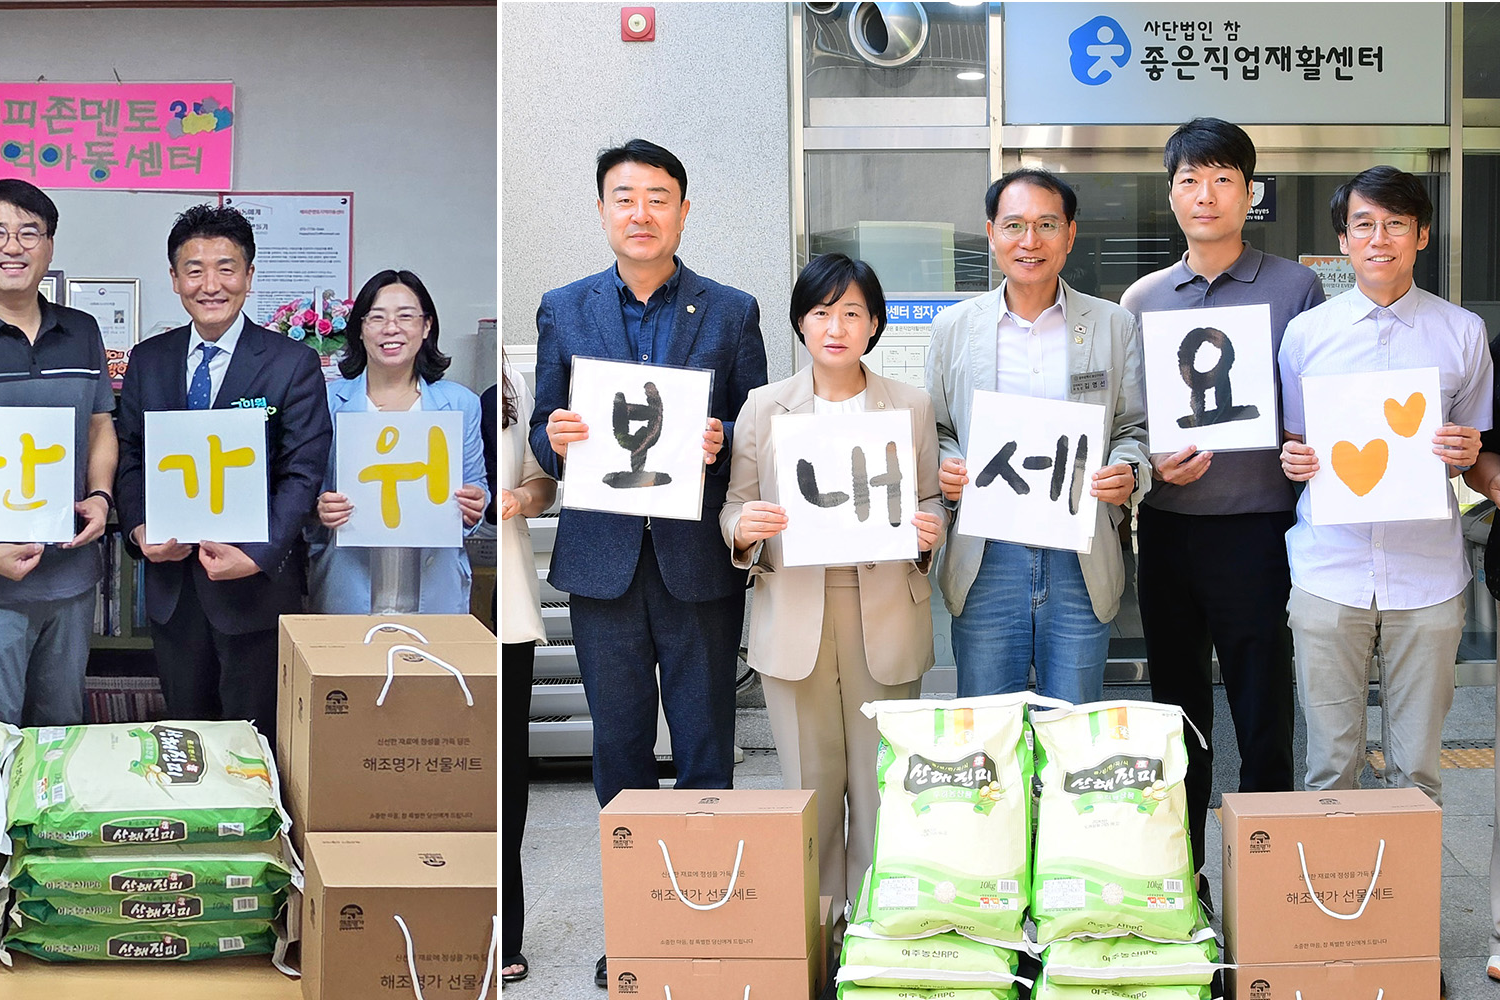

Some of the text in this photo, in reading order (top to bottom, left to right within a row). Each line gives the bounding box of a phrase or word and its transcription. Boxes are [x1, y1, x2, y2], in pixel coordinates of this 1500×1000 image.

[1143, 20, 1241, 41] 사단법인 참
[1140, 45, 1383, 81] 좋은직업재활센터
[913, 304, 934, 320] 점자
[1177, 327, 1260, 428] 요
[602, 381, 672, 488] 보
[158, 434, 256, 514] 가
[358, 424, 449, 529] 위
[975, 432, 1088, 516] 세
[796, 440, 902, 527] 내
[377, 738, 398, 746] 신선한
[363, 757, 483, 772] 해조명가 선물세트
[910, 763, 992, 787] 산해진미
[1070, 768, 1156, 790] 산해진미
[112, 826, 176, 842] 산해진미
[1337, 871, 1356, 879] 정성을
[121, 877, 184, 893] 산해진미
[980, 881, 996, 890] 10kg
[1147, 881, 1163, 890] 10kg
[130, 903, 192, 919] 산해진미
[118, 941, 178, 957] 산해진미
[902, 949, 959, 959] 여주농산RPC
